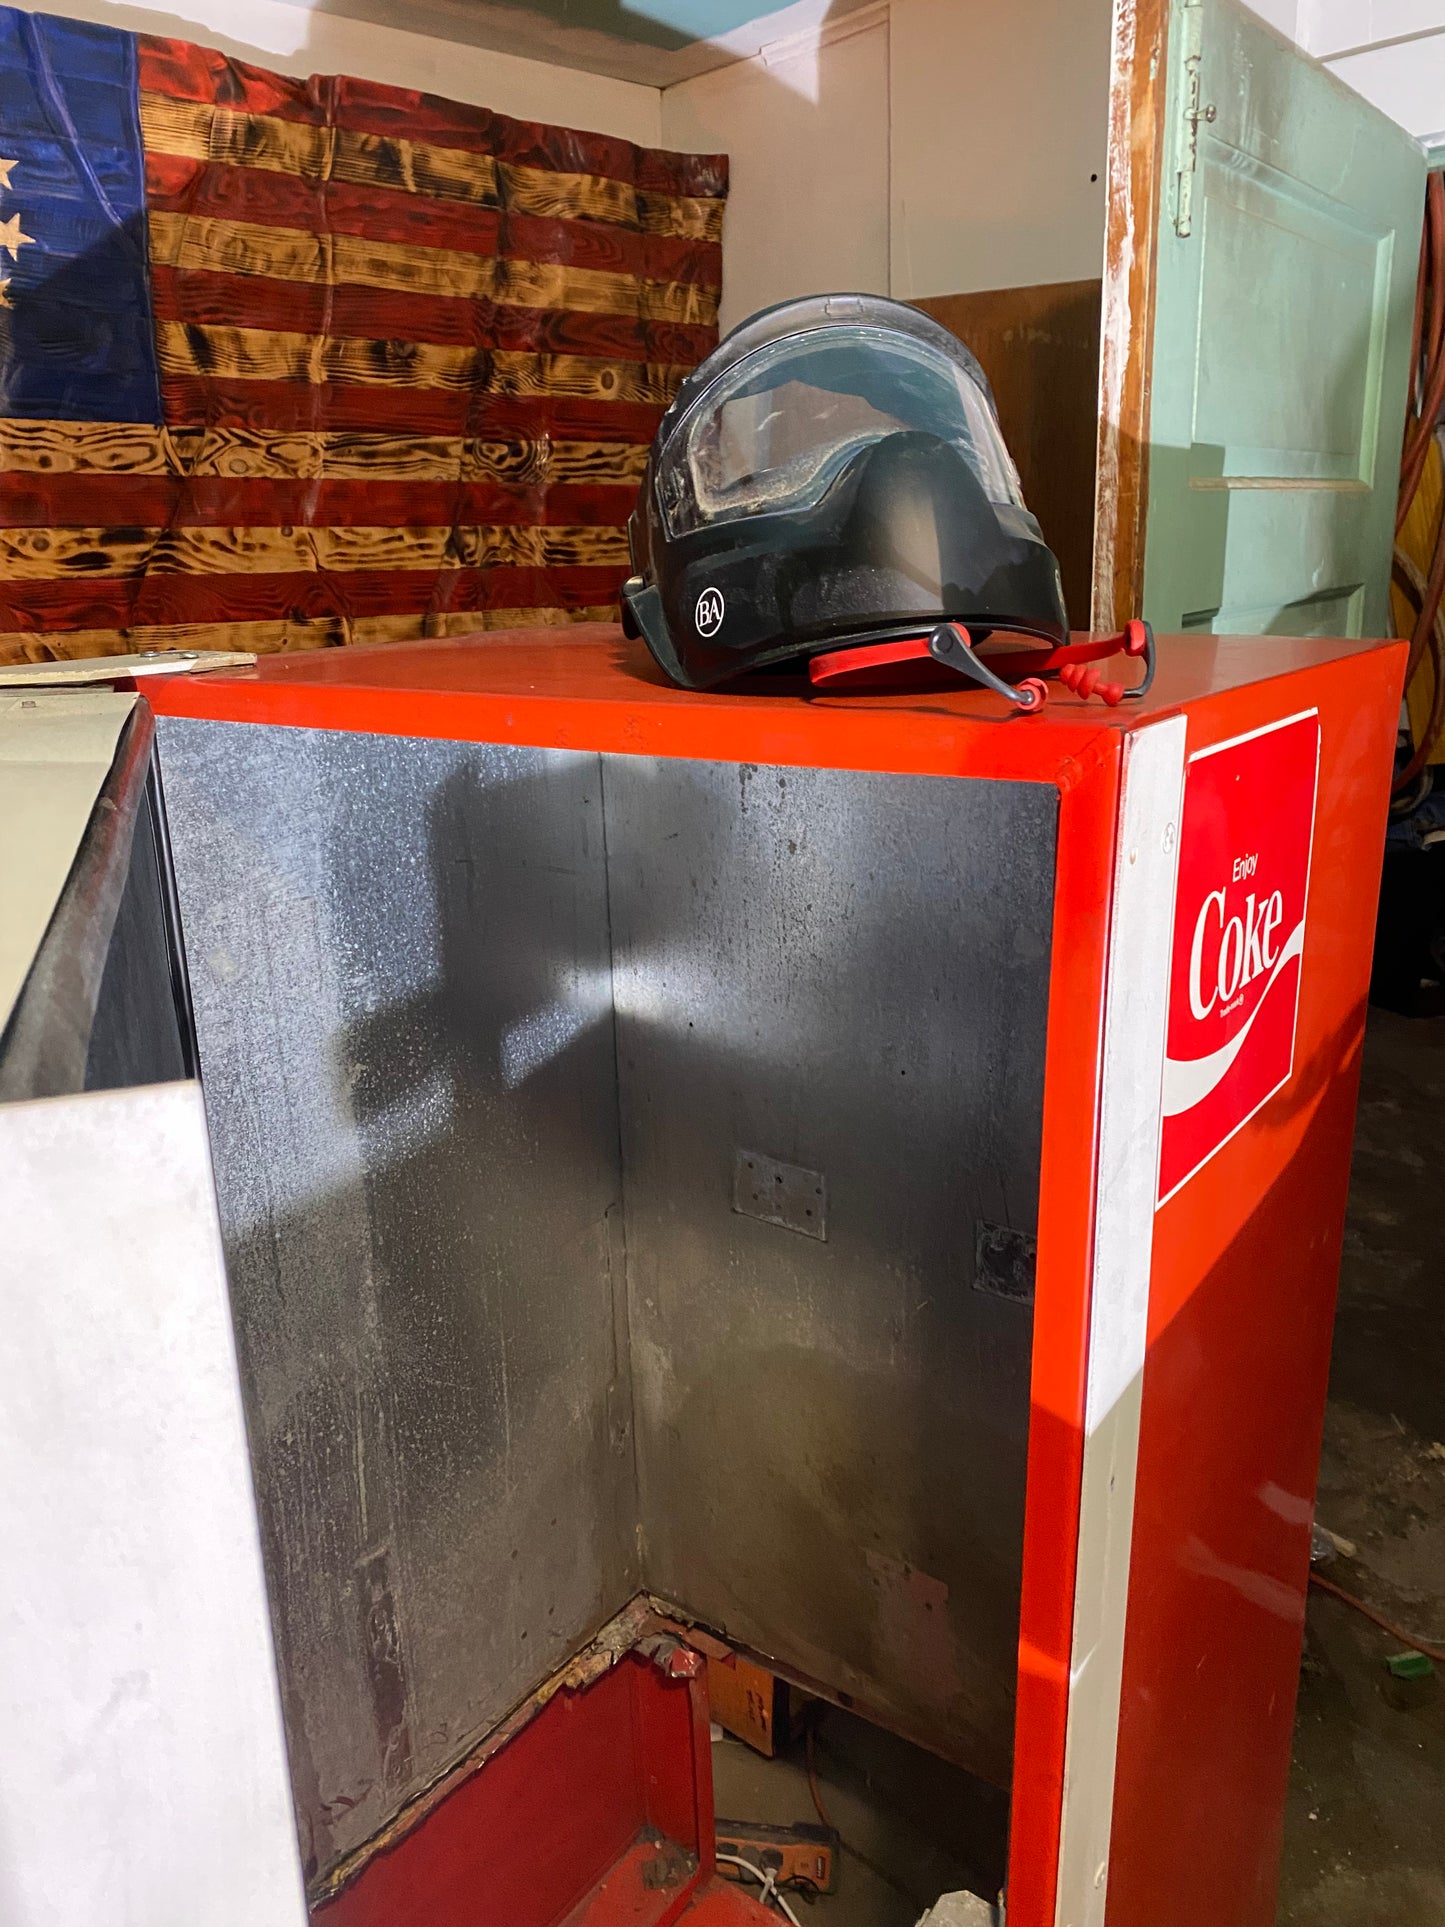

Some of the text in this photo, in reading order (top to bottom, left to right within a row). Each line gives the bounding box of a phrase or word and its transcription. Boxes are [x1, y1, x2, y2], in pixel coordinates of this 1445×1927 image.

[699, 596, 721, 627] BA
[1232, 853, 1258, 882] Enjoy
[1189, 886, 1283, 1020] Coke
